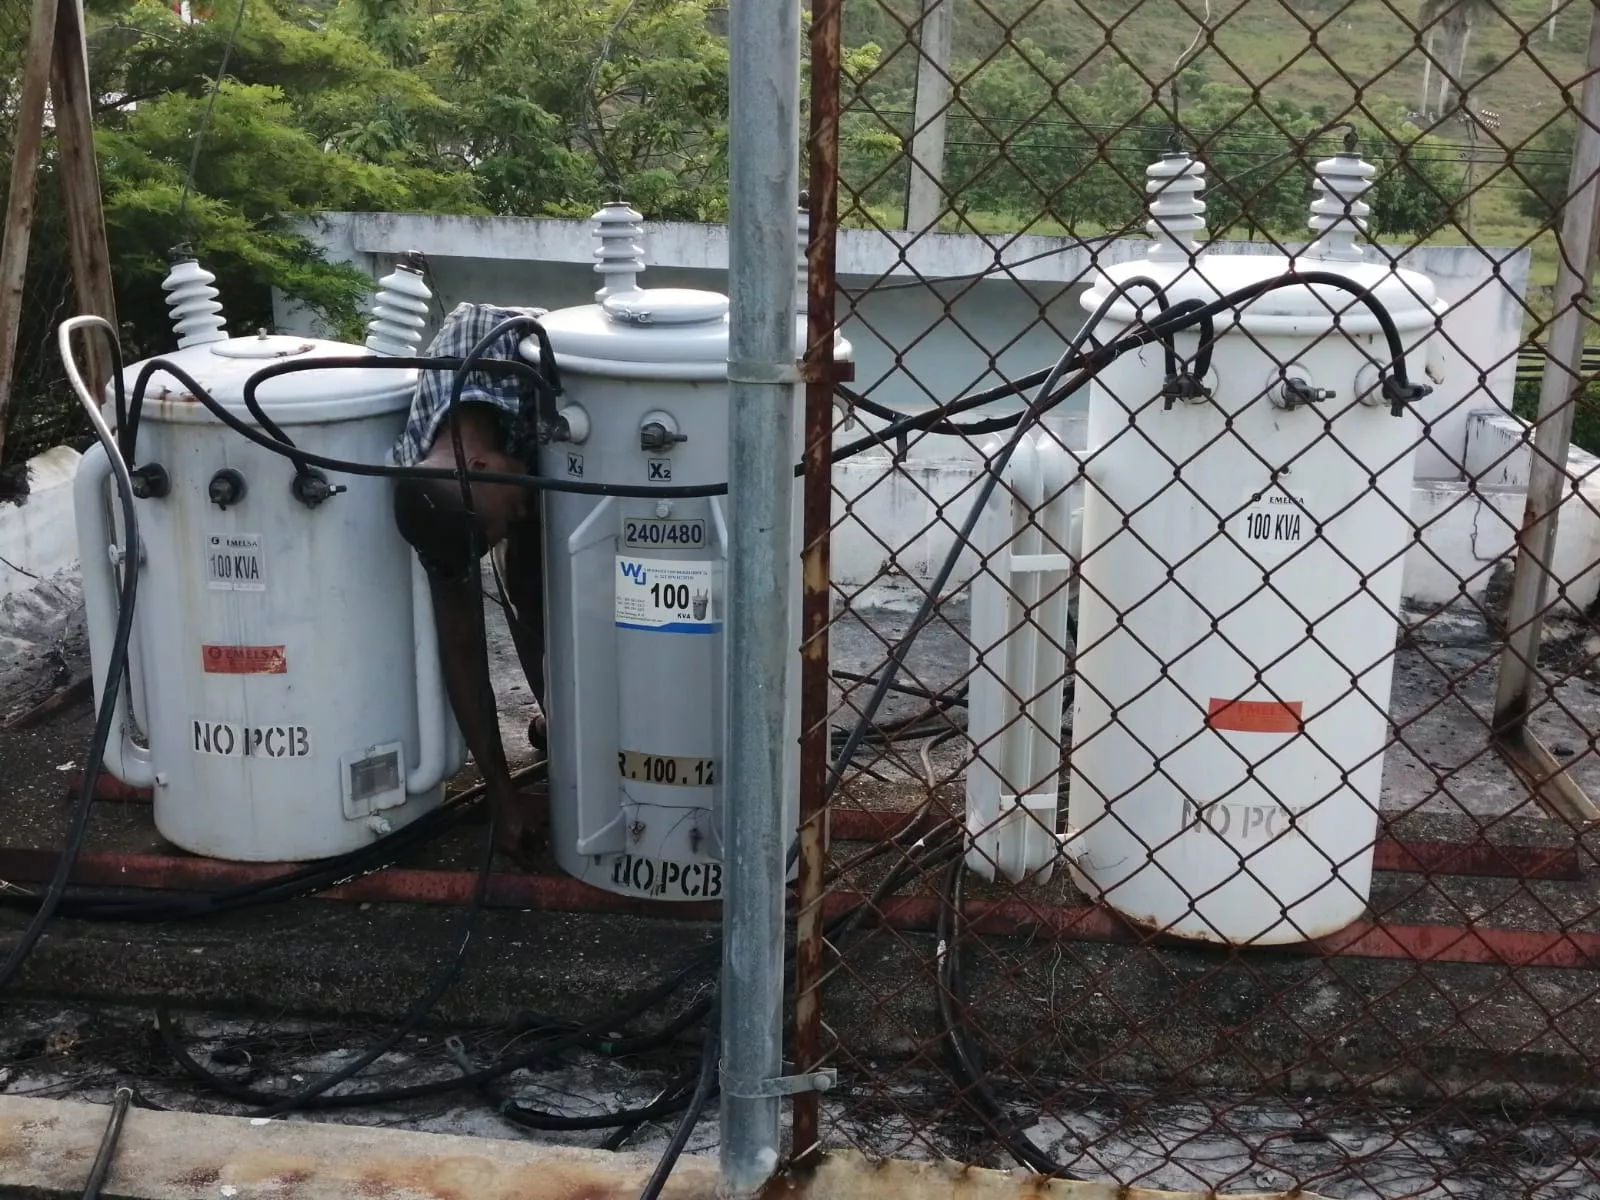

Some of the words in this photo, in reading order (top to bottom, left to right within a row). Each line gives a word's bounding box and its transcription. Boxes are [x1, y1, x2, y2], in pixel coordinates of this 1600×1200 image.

[626, 522, 702, 543] 240/480
[1247, 512, 1271, 540] 100
[1274, 513, 1300, 541] KVA
[210, 553, 232, 578] 100
[234, 555, 259, 579] KVA
[650, 582, 690, 610] 100
[193, 720, 235, 755] NO
[244, 726, 310, 757] PCB
[1181, 798, 1231, 836] NO
[660, 861, 722, 897] PCB
